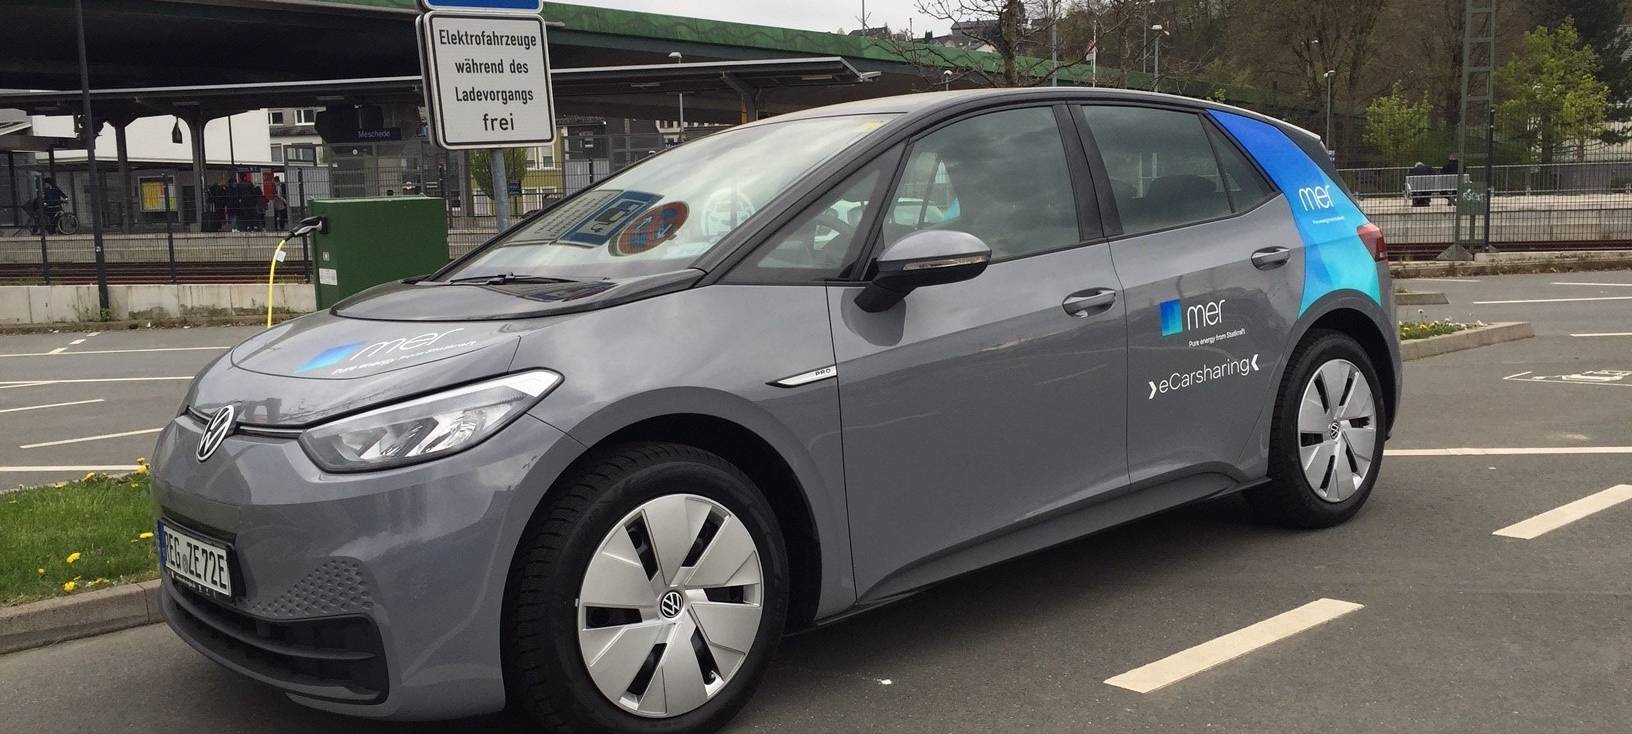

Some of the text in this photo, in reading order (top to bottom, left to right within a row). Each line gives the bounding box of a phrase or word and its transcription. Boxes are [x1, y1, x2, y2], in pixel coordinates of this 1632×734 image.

[439, 29, 537, 50] Elektrofahrzeuge
[455, 58, 529, 73] während des
[455, 86, 534, 104] Ladevorgangs
[483, 113, 515, 131] frei
[1298, 184, 1335, 212] mer
[1187, 299, 1226, 331] mer
[350, 328, 465, 360] mer
[815, 368, 832, 376] PRO
[1159, 358, 1250, 393] eCarsharing
